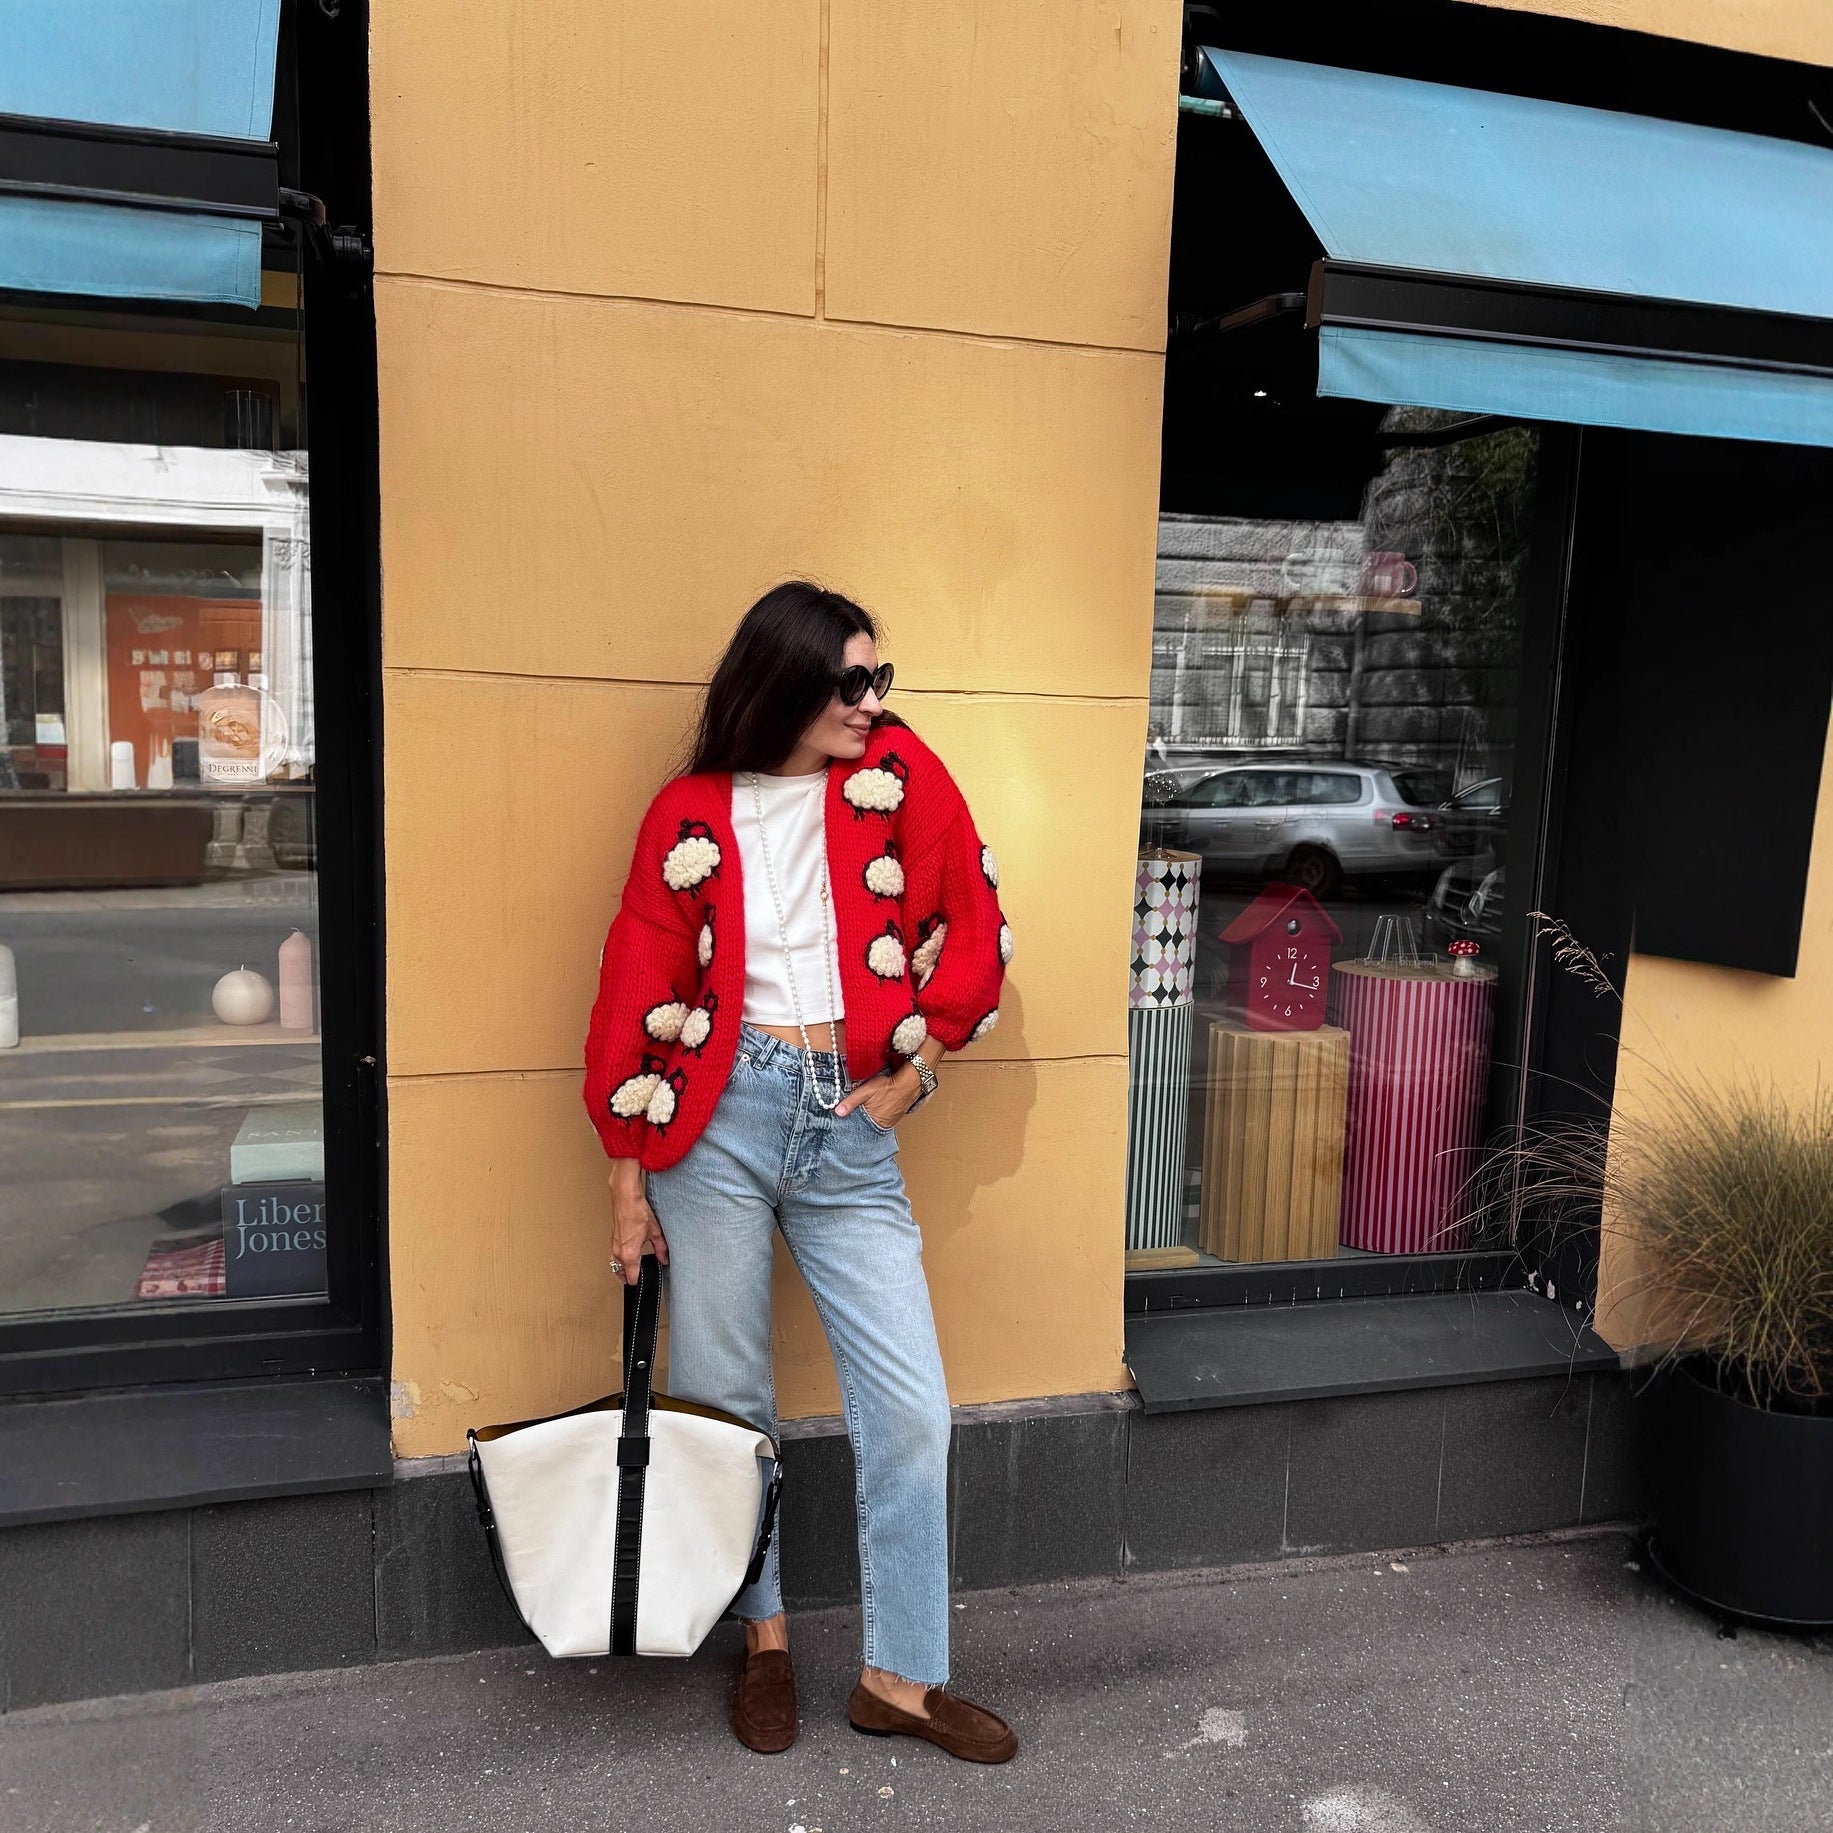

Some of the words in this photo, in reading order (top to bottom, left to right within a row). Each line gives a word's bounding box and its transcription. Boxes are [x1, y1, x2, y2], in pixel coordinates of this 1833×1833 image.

[1287, 947, 1298, 959] 12
[1260, 976, 1268, 988] 9
[1312, 976, 1320, 987] 3
[1284, 1005, 1292, 1017] 6
[236, 1197, 326, 1227] Liber
[235, 1225, 327, 1260] Jones
